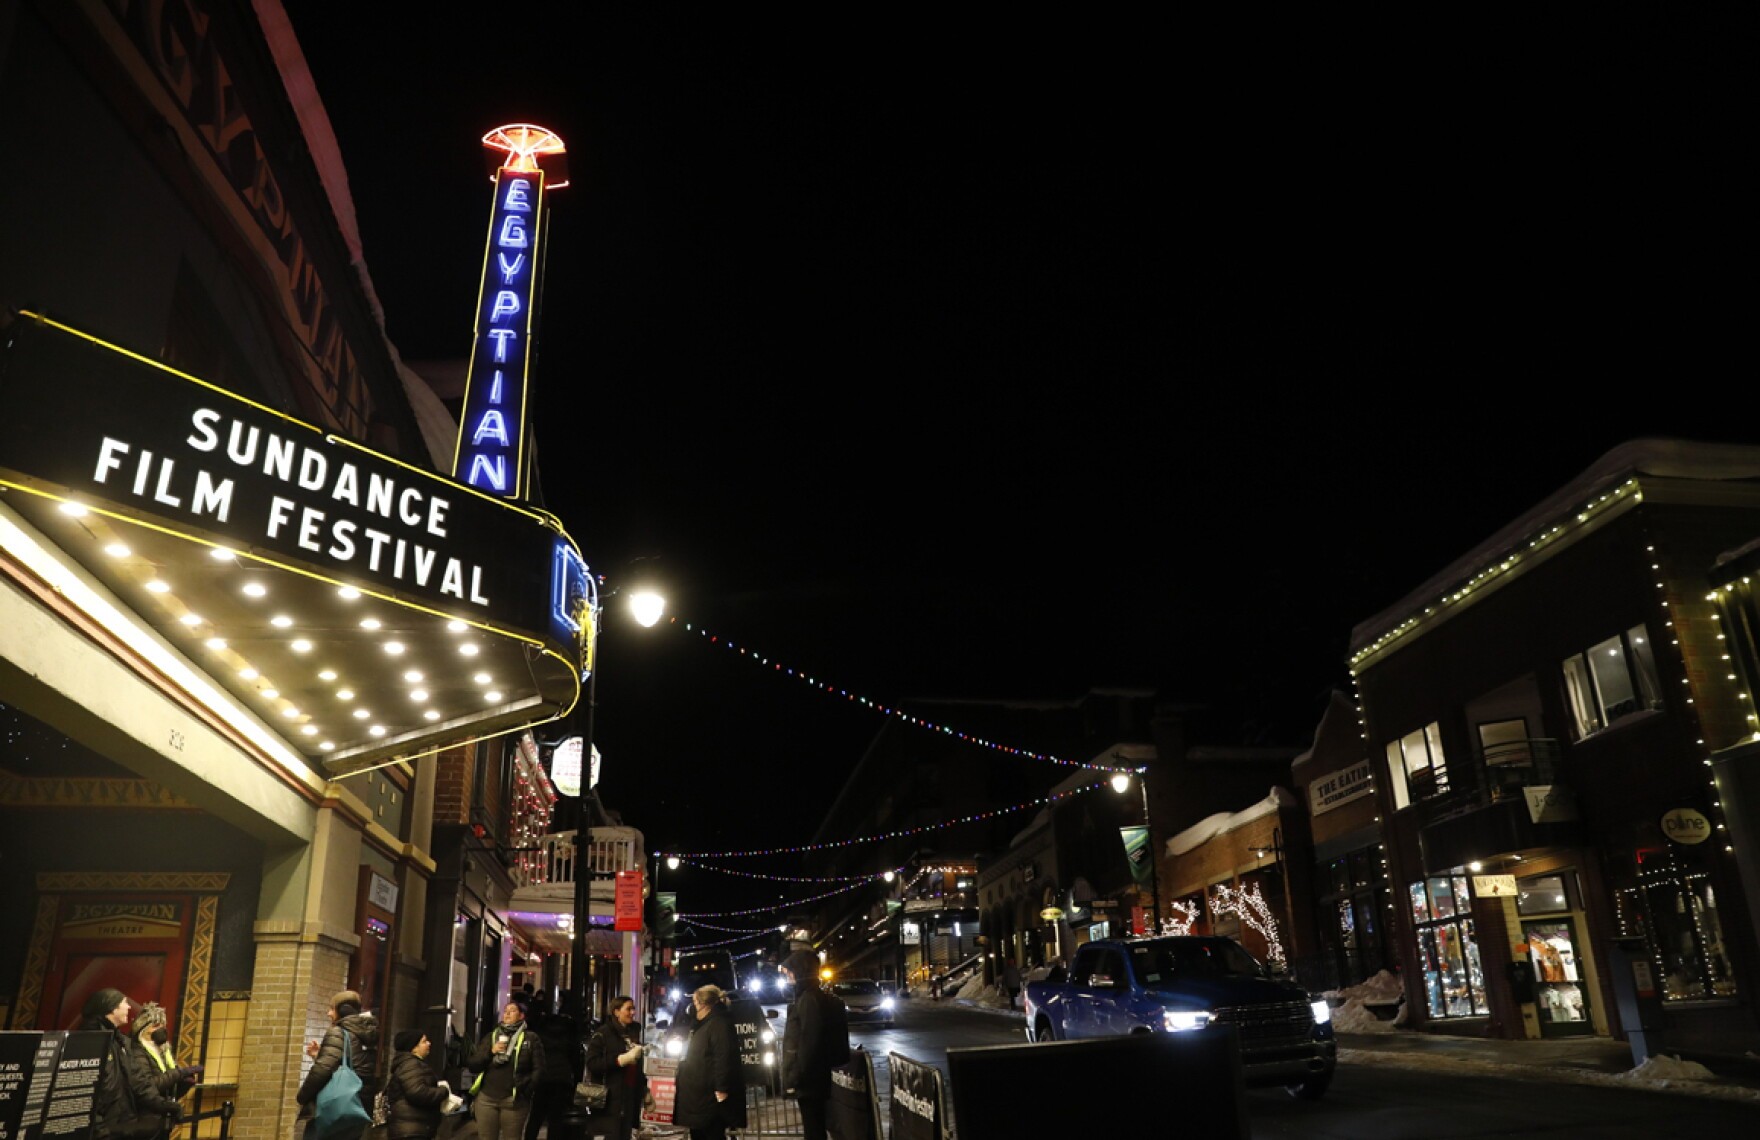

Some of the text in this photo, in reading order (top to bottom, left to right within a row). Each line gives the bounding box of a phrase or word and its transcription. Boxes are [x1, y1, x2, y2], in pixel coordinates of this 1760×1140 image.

[468, 178, 532, 491] EGYPTIAN
[186, 408, 450, 538] SUNDANCE
[93, 436, 235, 523] FILM
[267, 496, 489, 606] FESTIVAL
[1317, 778, 1336, 798] THE
[71, 903, 177, 920] EGYPTIAN
[97, 926, 144, 936] THEATRE
[735, 1022, 758, 1035] TION:
[743, 1038, 758, 1050] ICY
[740, 1052, 761, 1065] FACE
